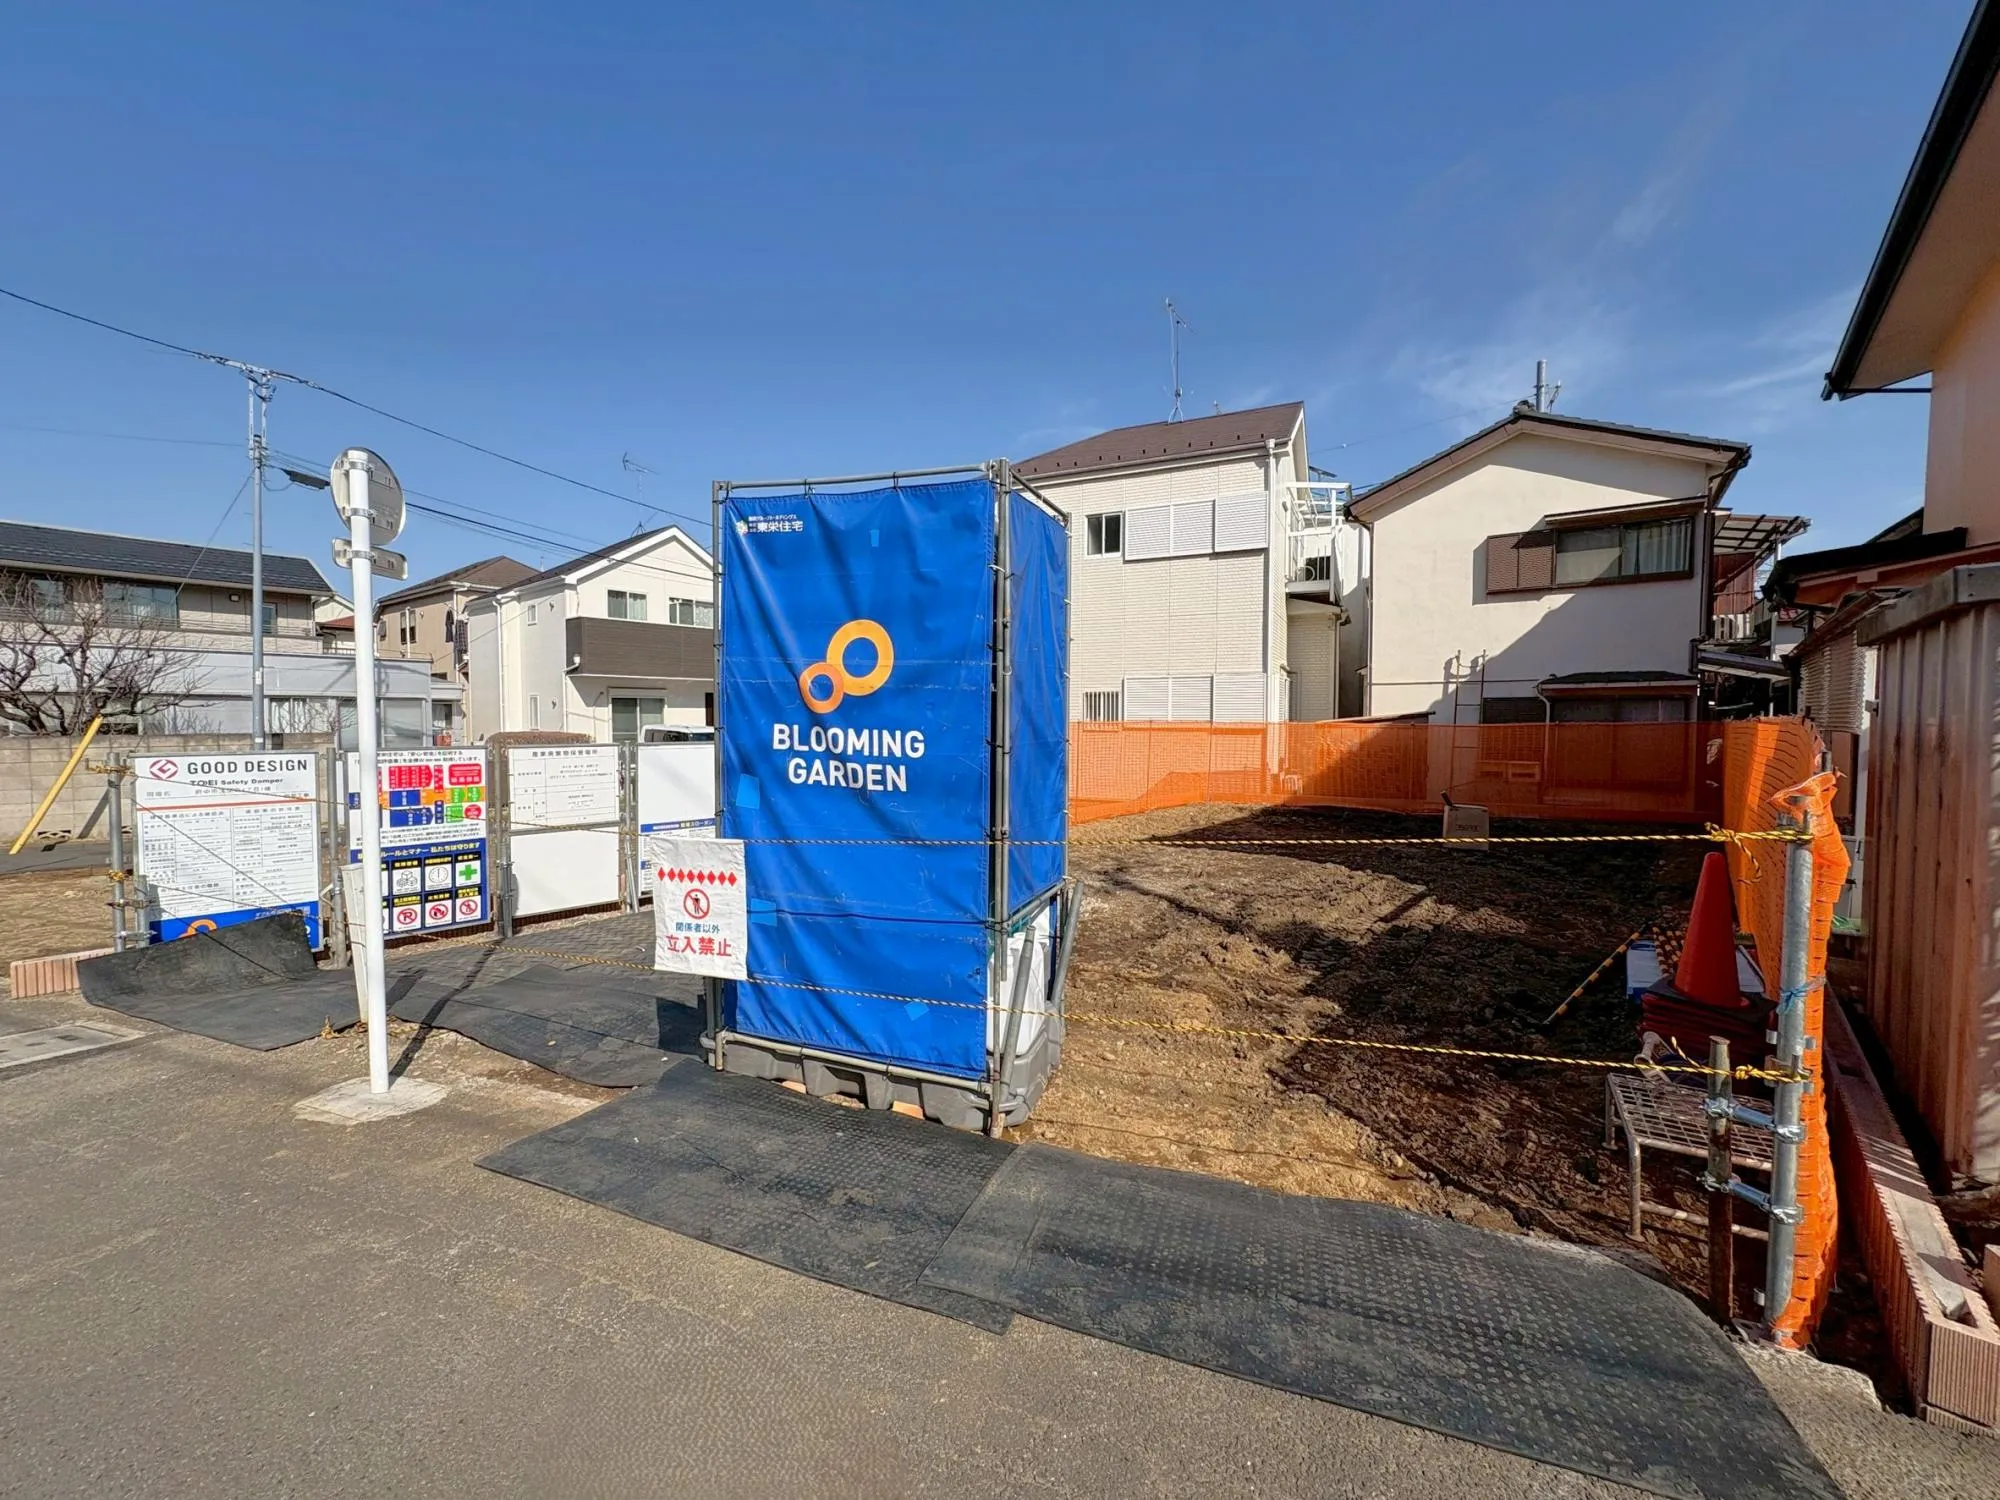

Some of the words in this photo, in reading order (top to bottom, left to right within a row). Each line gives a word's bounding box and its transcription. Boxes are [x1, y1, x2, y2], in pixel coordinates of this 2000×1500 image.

[757, 521, 804, 533] 東栄住宅
[773, 724, 925, 758] BLOOMING
[188, 762, 237, 774] GOOD
[245, 759, 308, 773] DESIGN
[788, 757, 908, 792] GARDEN
[675, 922, 721, 934] 関係者以外
[666, 935, 733, 957] 立入禁止
